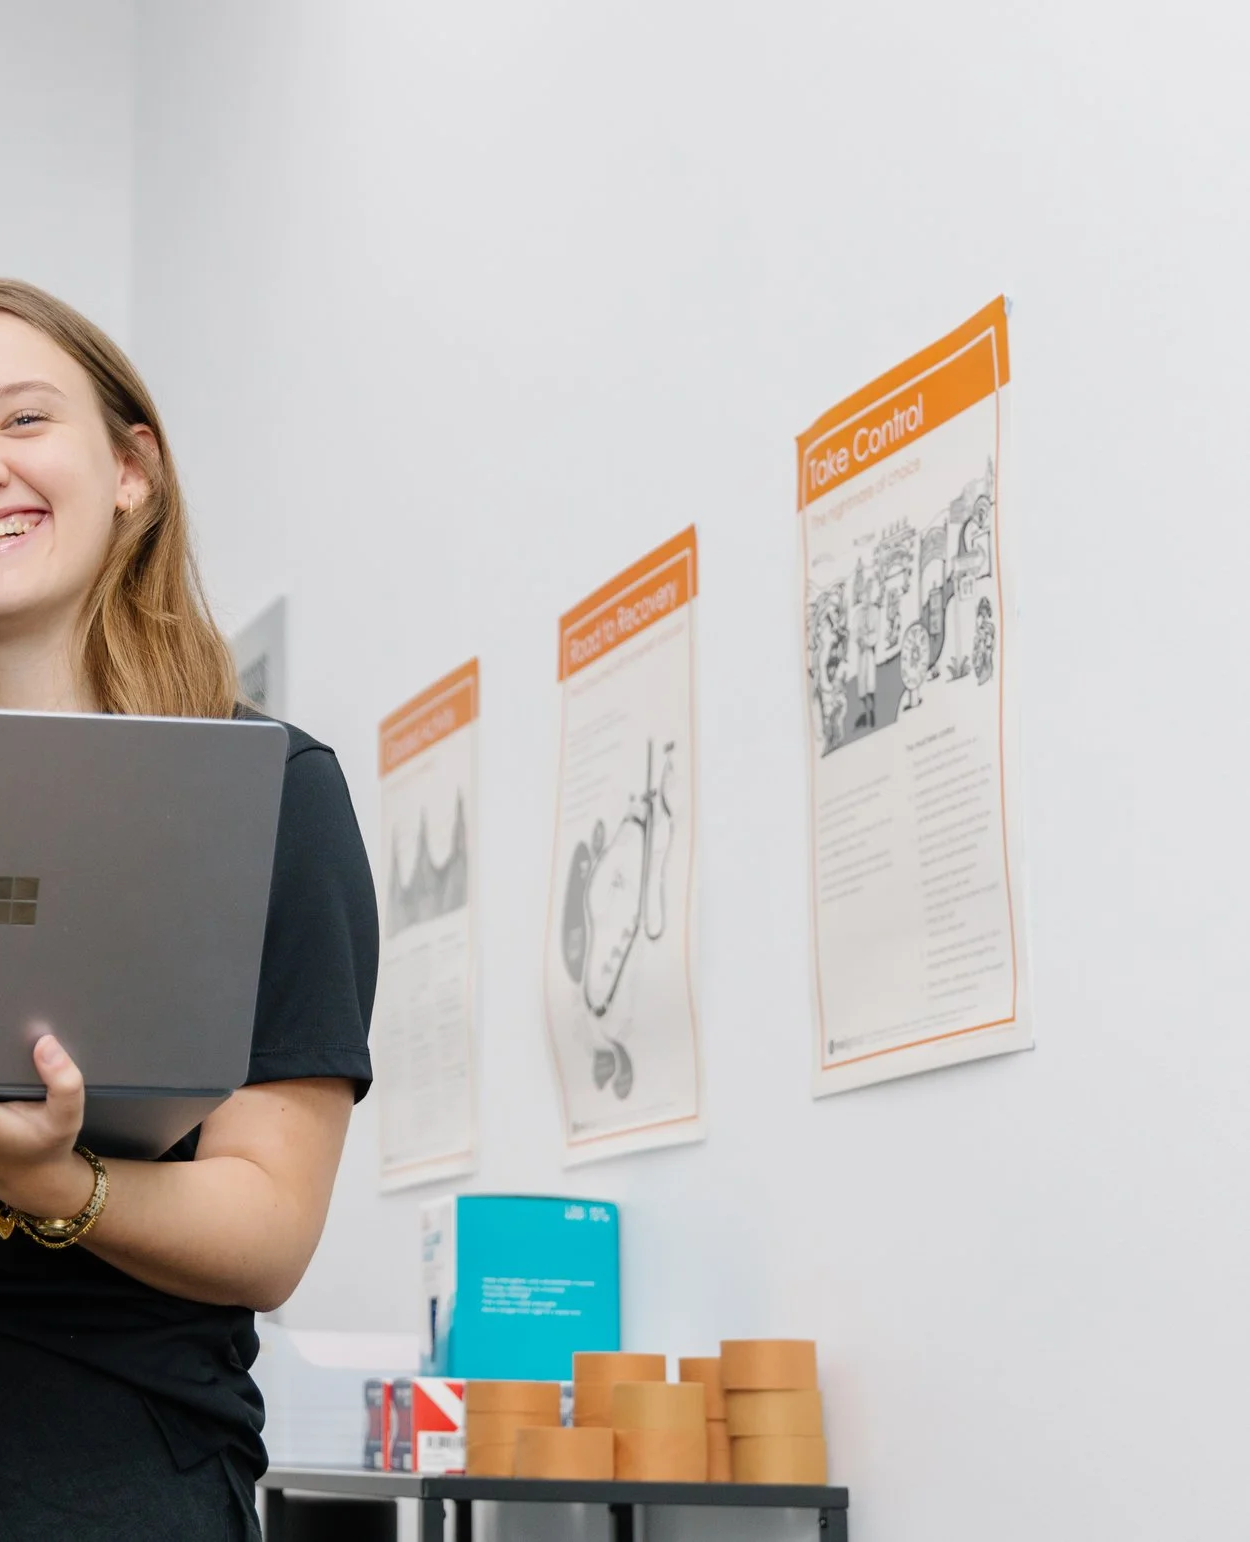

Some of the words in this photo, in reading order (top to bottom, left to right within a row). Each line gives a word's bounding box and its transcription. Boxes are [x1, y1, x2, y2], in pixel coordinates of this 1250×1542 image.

[809, 447, 850, 490] Take
[852, 391, 924, 463] Control
[617, 578, 679, 635] Recovery
